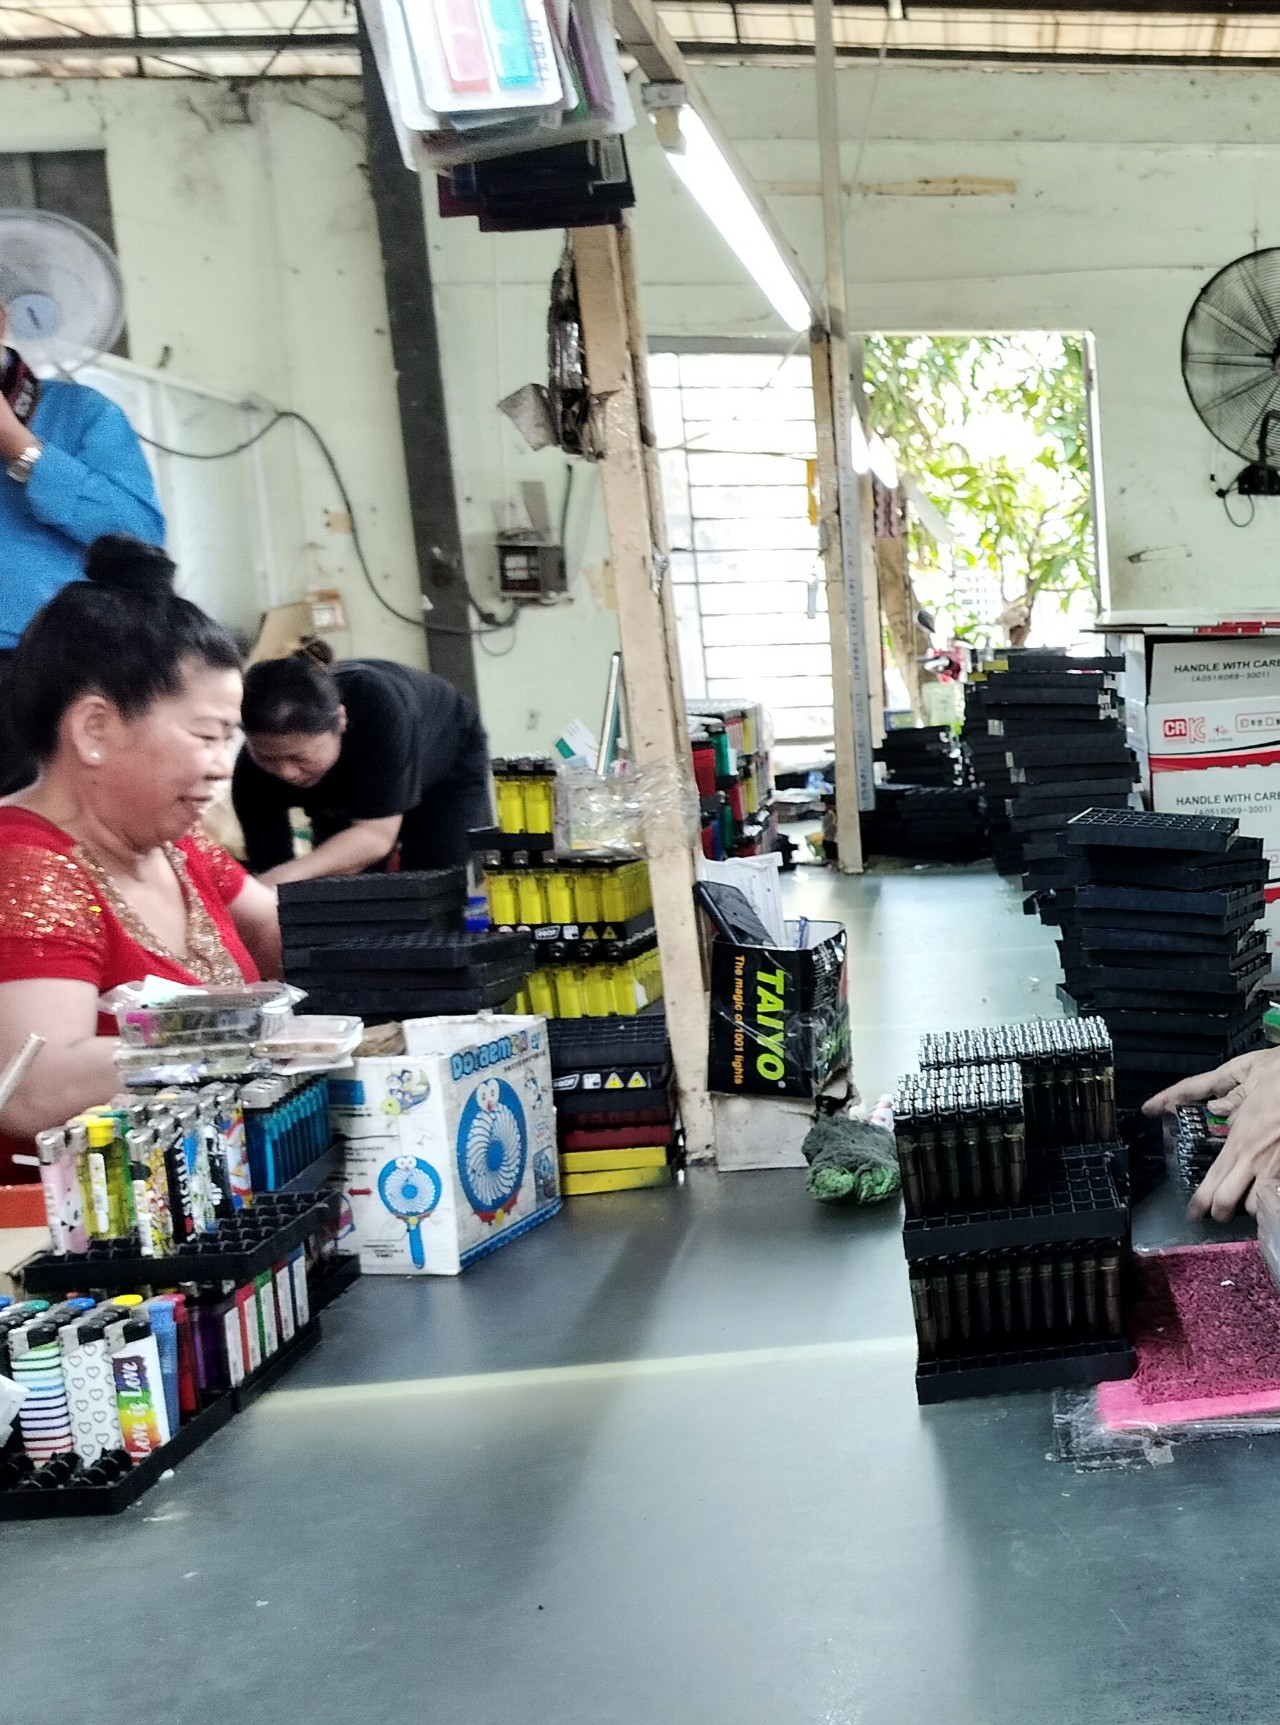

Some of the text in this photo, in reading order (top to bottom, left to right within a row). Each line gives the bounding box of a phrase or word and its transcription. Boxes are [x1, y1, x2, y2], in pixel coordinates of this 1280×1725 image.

[1174, 662, 1219, 673] HANDLE
[1222, 660, 1251, 670] WITH
[1164, 720, 1186, 736] CR
[1176, 794, 1221, 806] HANDLE
[1223, 793, 1251, 803] WITH
[734, 955, 746, 976] The
[732, 978, 745, 1011] magic
[756, 968, 785, 1081] TAIYO
[734, 1028, 745, 1052] 1001
[732, 1055, 745, 1085] lights
[120, 1361, 142, 1397] Love
